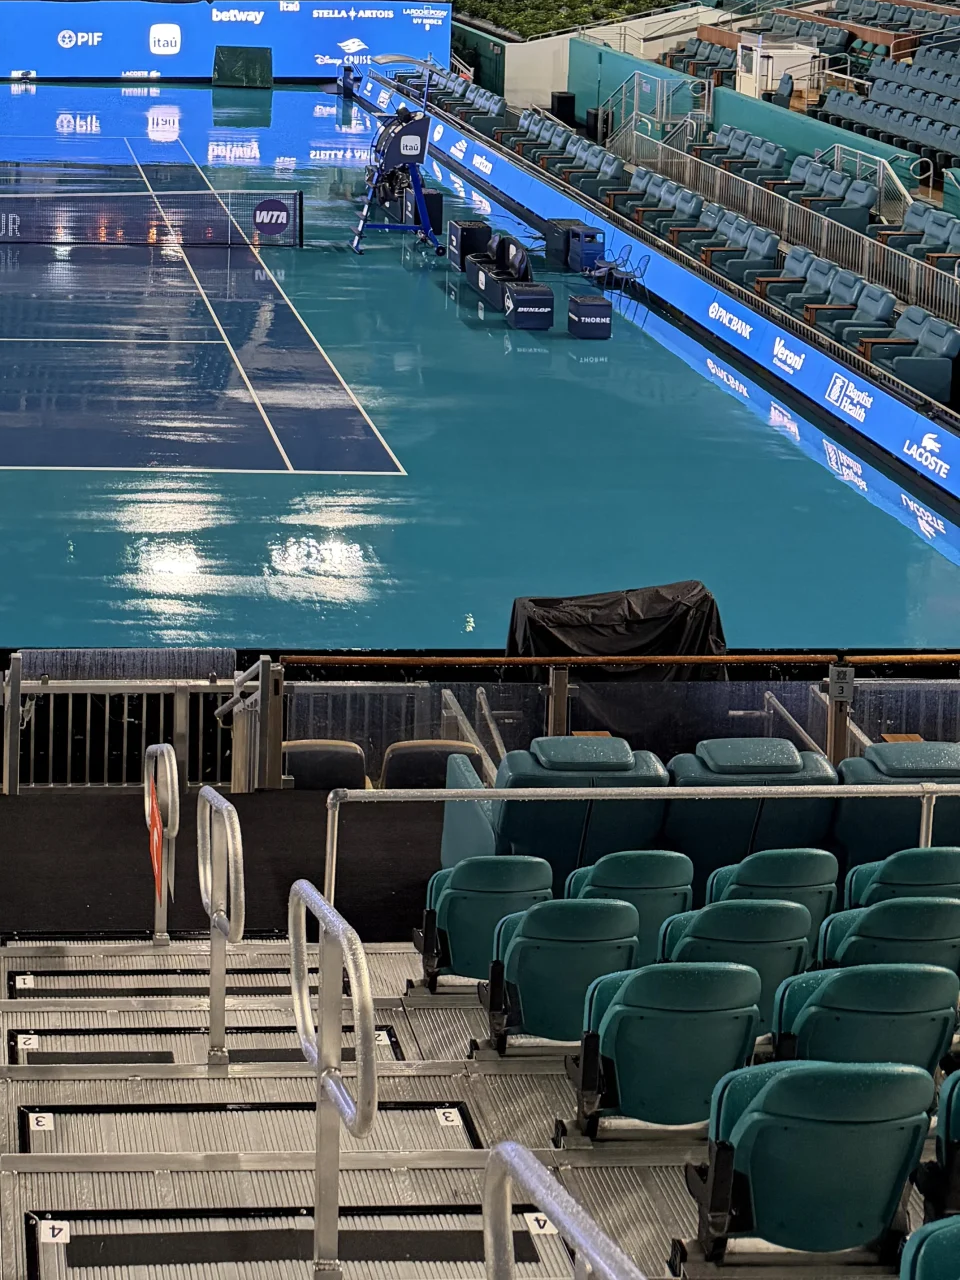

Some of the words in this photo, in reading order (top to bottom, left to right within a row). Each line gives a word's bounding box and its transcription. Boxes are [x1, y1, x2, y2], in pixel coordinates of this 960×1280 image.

[212, 8, 265, 24] betway
[312, 9, 347, 18] STELLA
[358, 10, 394, 18] ARTOIS
[77, 32, 103, 45] PIF
[152, 36, 178, 48] itaú
[314, 54, 343, 67] Disney
[343, 55, 371, 64] CRUISE
[402, 143, 419, 152] itaú
[255, 210, 288, 224] WTA
[581, 316, 611, 324] THORNE
[773, 336, 806, 370] Veroni
[846, 382, 874, 410] Baptist
[839, 397, 867, 423] Health
[902, 438, 951, 479] LACOSTE
[837, 685, 844, 695] 3
[22, 1036, 34, 1046] 2
[34, 1114, 47, 1128] 3
[441, 1109, 457, 1124] 3
[532, 1215, 549, 1231] 4
[48, 1224, 64, 1239] 4
